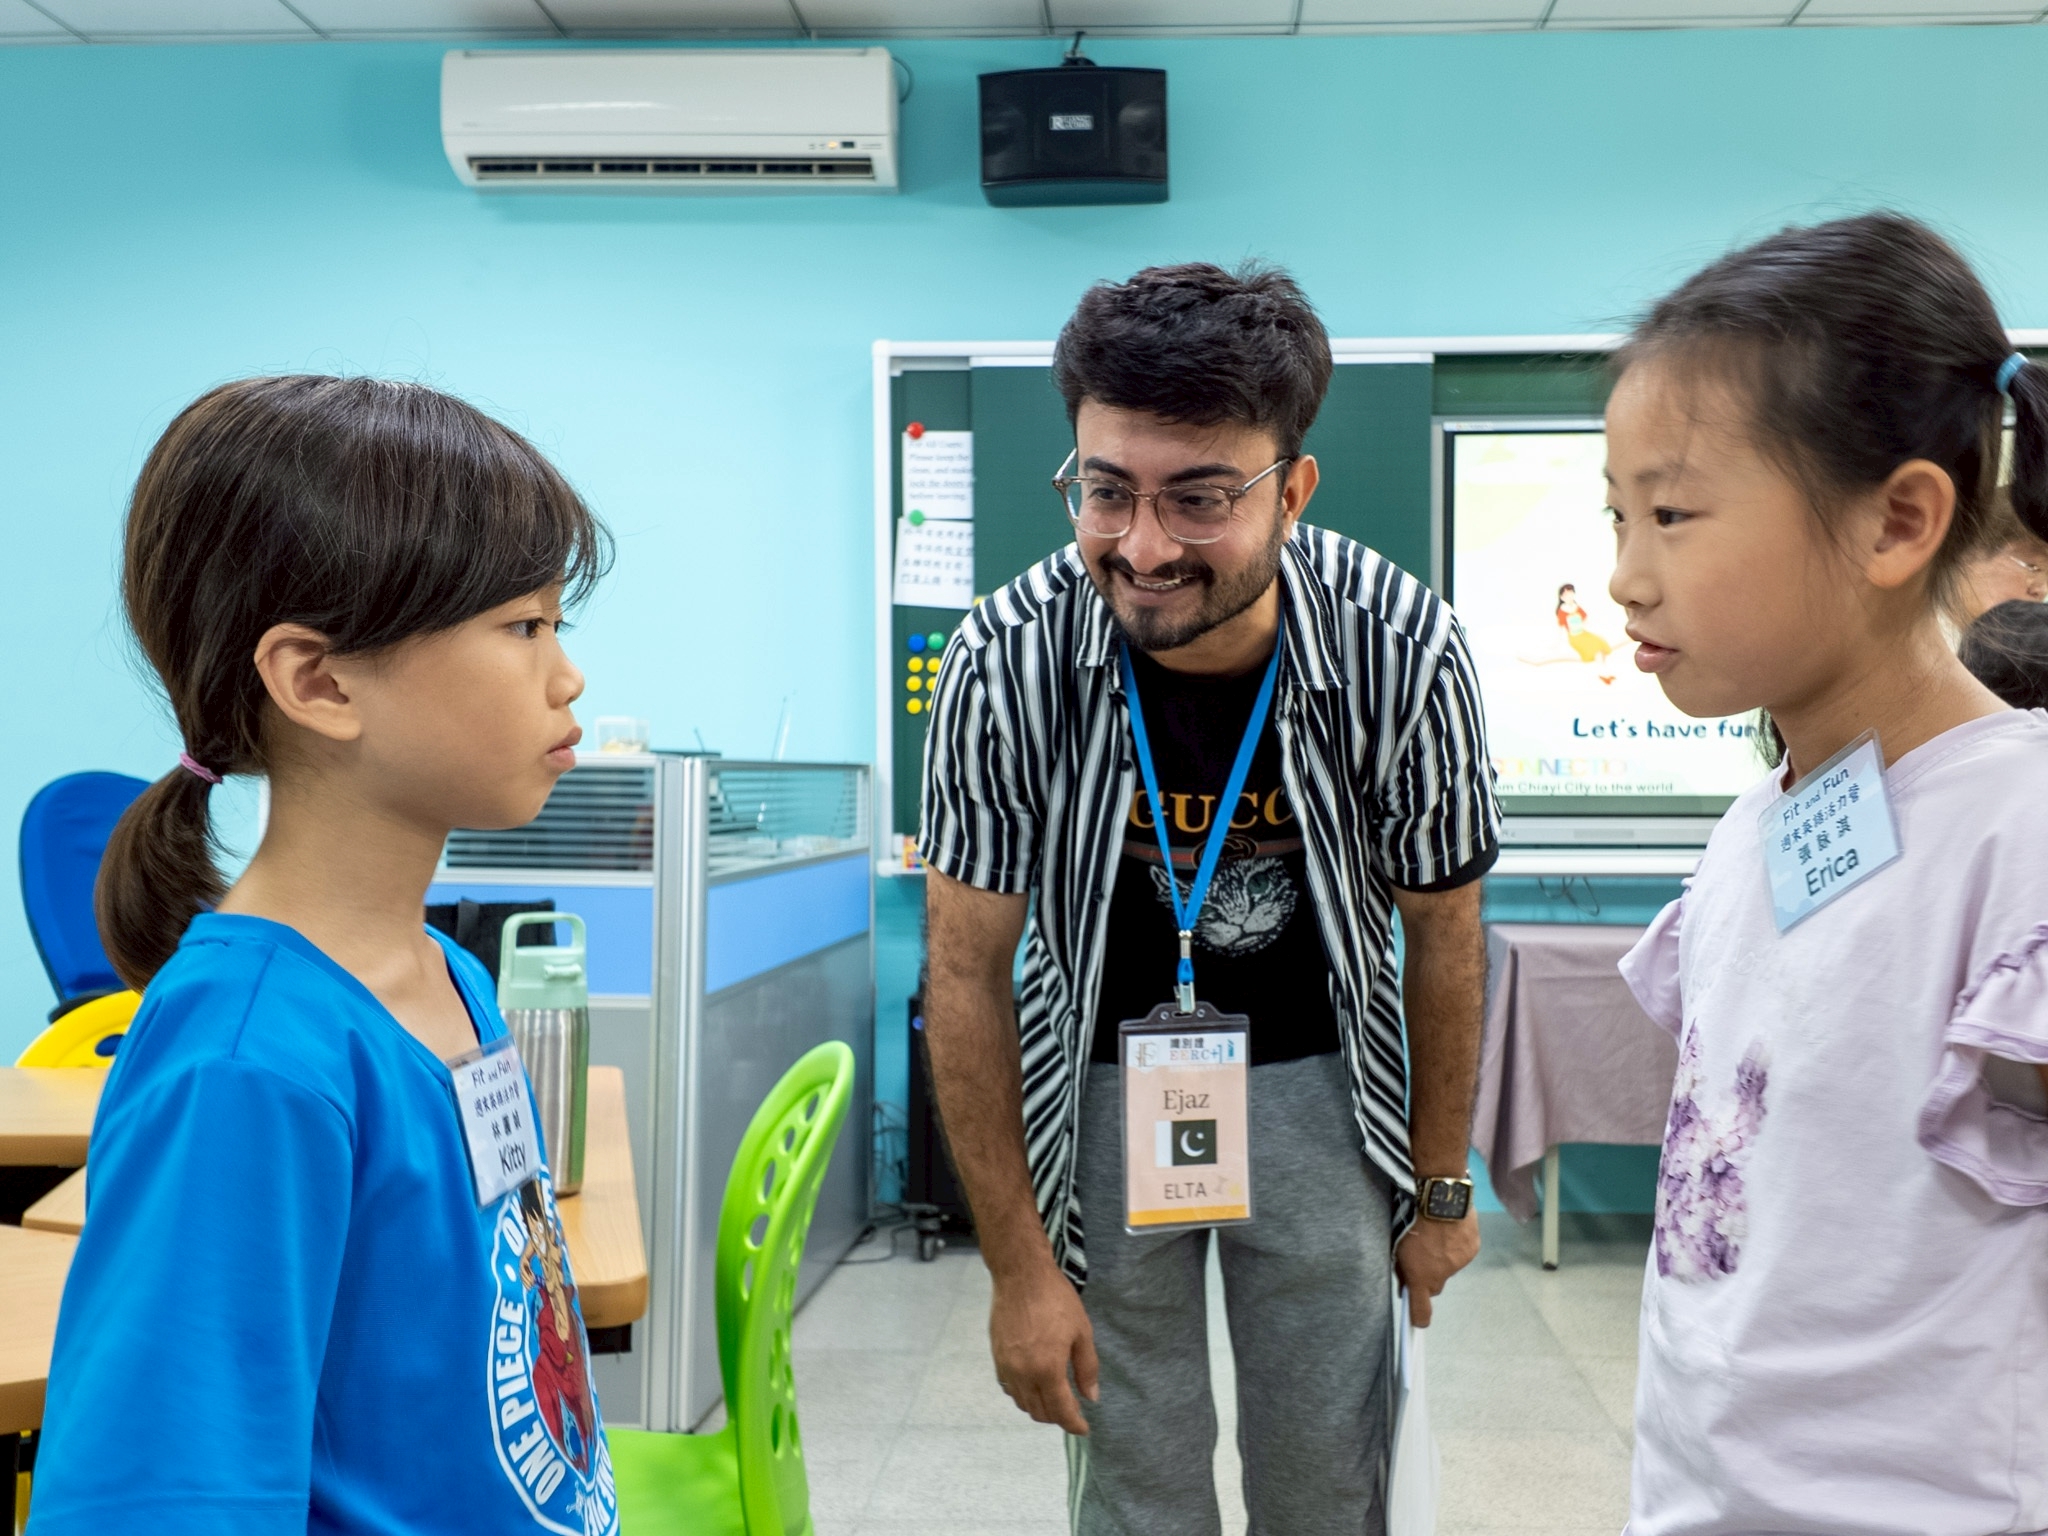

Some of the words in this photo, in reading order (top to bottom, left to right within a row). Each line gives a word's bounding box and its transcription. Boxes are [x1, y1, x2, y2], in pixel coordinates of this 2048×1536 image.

[1572, 718, 1638, 739] Let's
[1647, 719, 1707, 739] have
[1718, 719, 1759, 739] fun
[1128, 786, 1293, 834] GUCC
[1565, 782, 1591, 796] City
[1595, 783, 1608, 793] to
[1611, 782, 1632, 793] the
[1636, 782, 1674, 793] world
[1782, 801, 1800, 827] Fit
[1804, 788, 1821, 810] and
[1822, 768, 1850, 796] Fun
[1779, 782, 1860, 854] 週末英語活力營
[1804, 847, 1860, 897] Erica
[471, 1065, 486, 1089] Fit
[496, 1059, 512, 1077] Fun
[1162, 1089, 1211, 1115] Ejaz
[498, 1141, 527, 1177] Kitty
[1163, 1182, 1208, 1200] ELTA
[496, 1296, 536, 1431] PIECE
[508, 1419, 566, 1506] ONE
